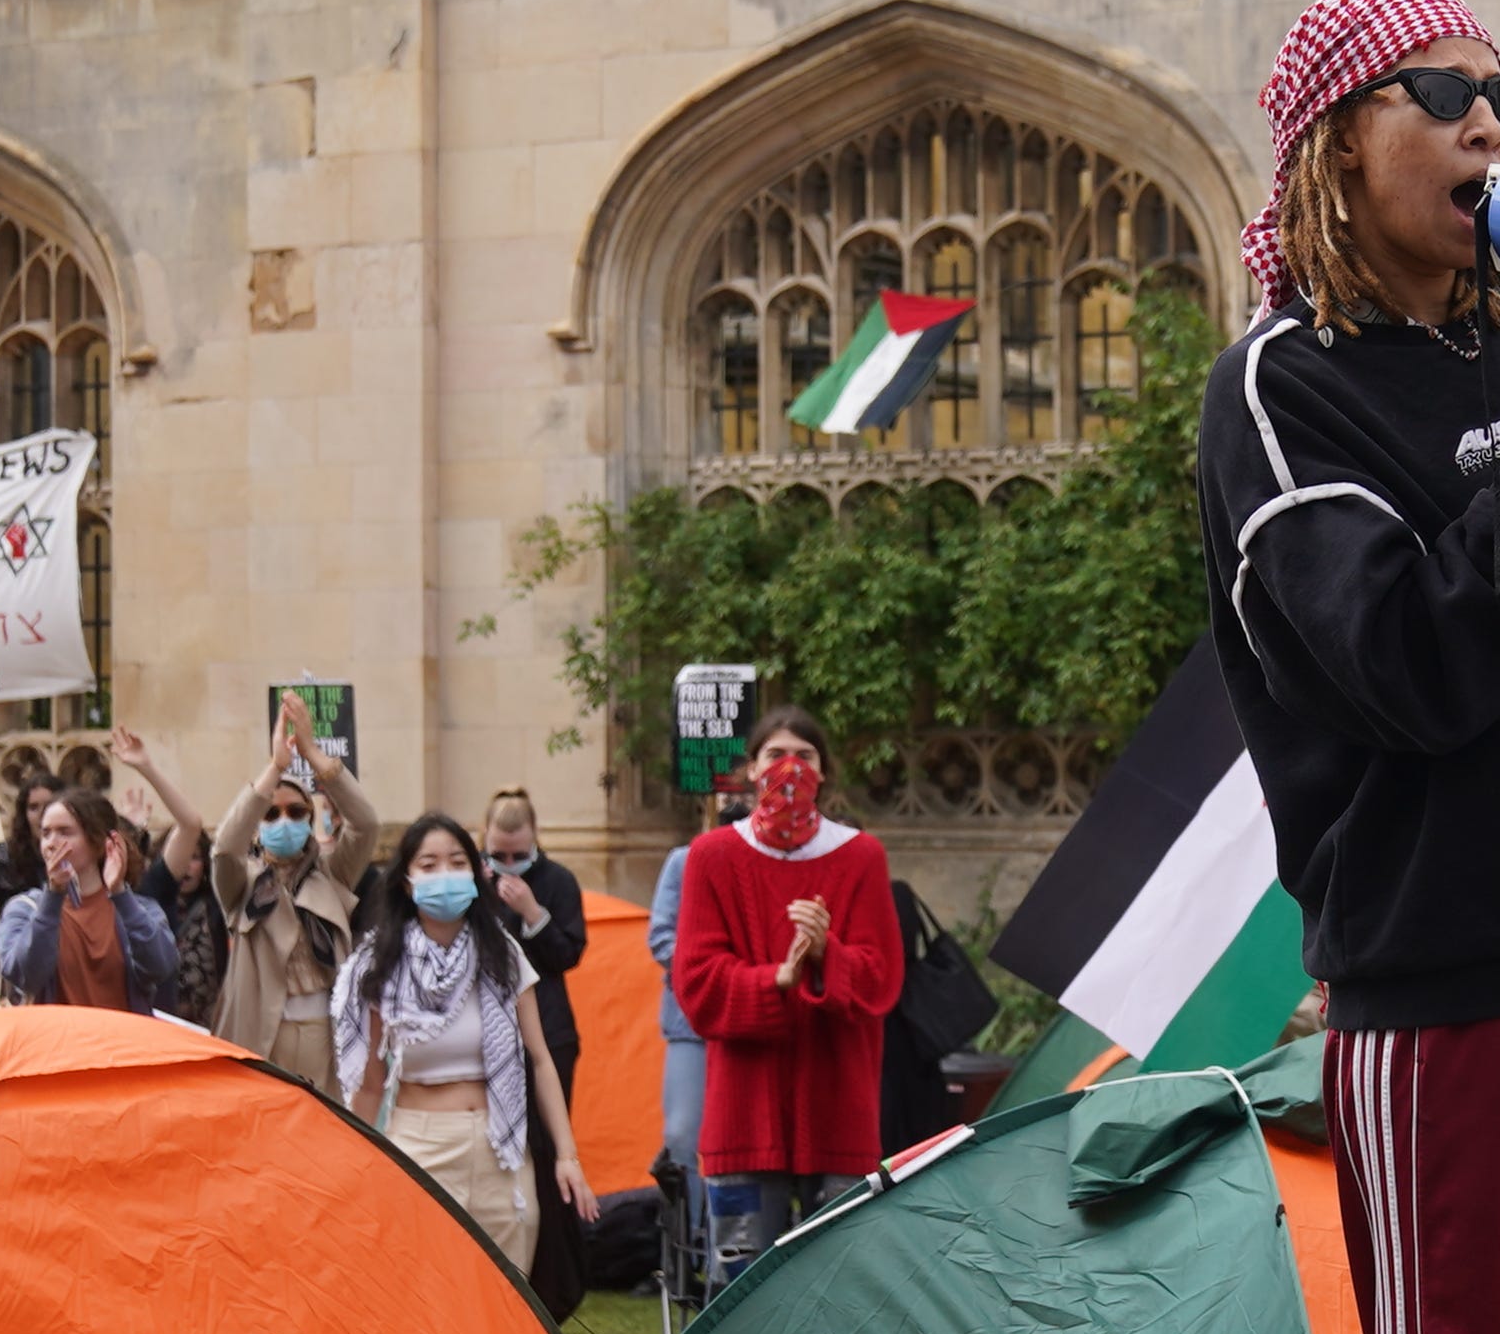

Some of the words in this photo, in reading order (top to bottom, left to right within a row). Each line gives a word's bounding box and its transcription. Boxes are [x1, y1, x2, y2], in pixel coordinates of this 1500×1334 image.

[678, 682, 717, 701] FROM
[719, 682, 745, 702] THE
[678, 701, 718, 719] RIVER
[720, 701, 739, 720] TO
[678, 719, 705, 738] THE
[705, 719, 735, 738] SEA
